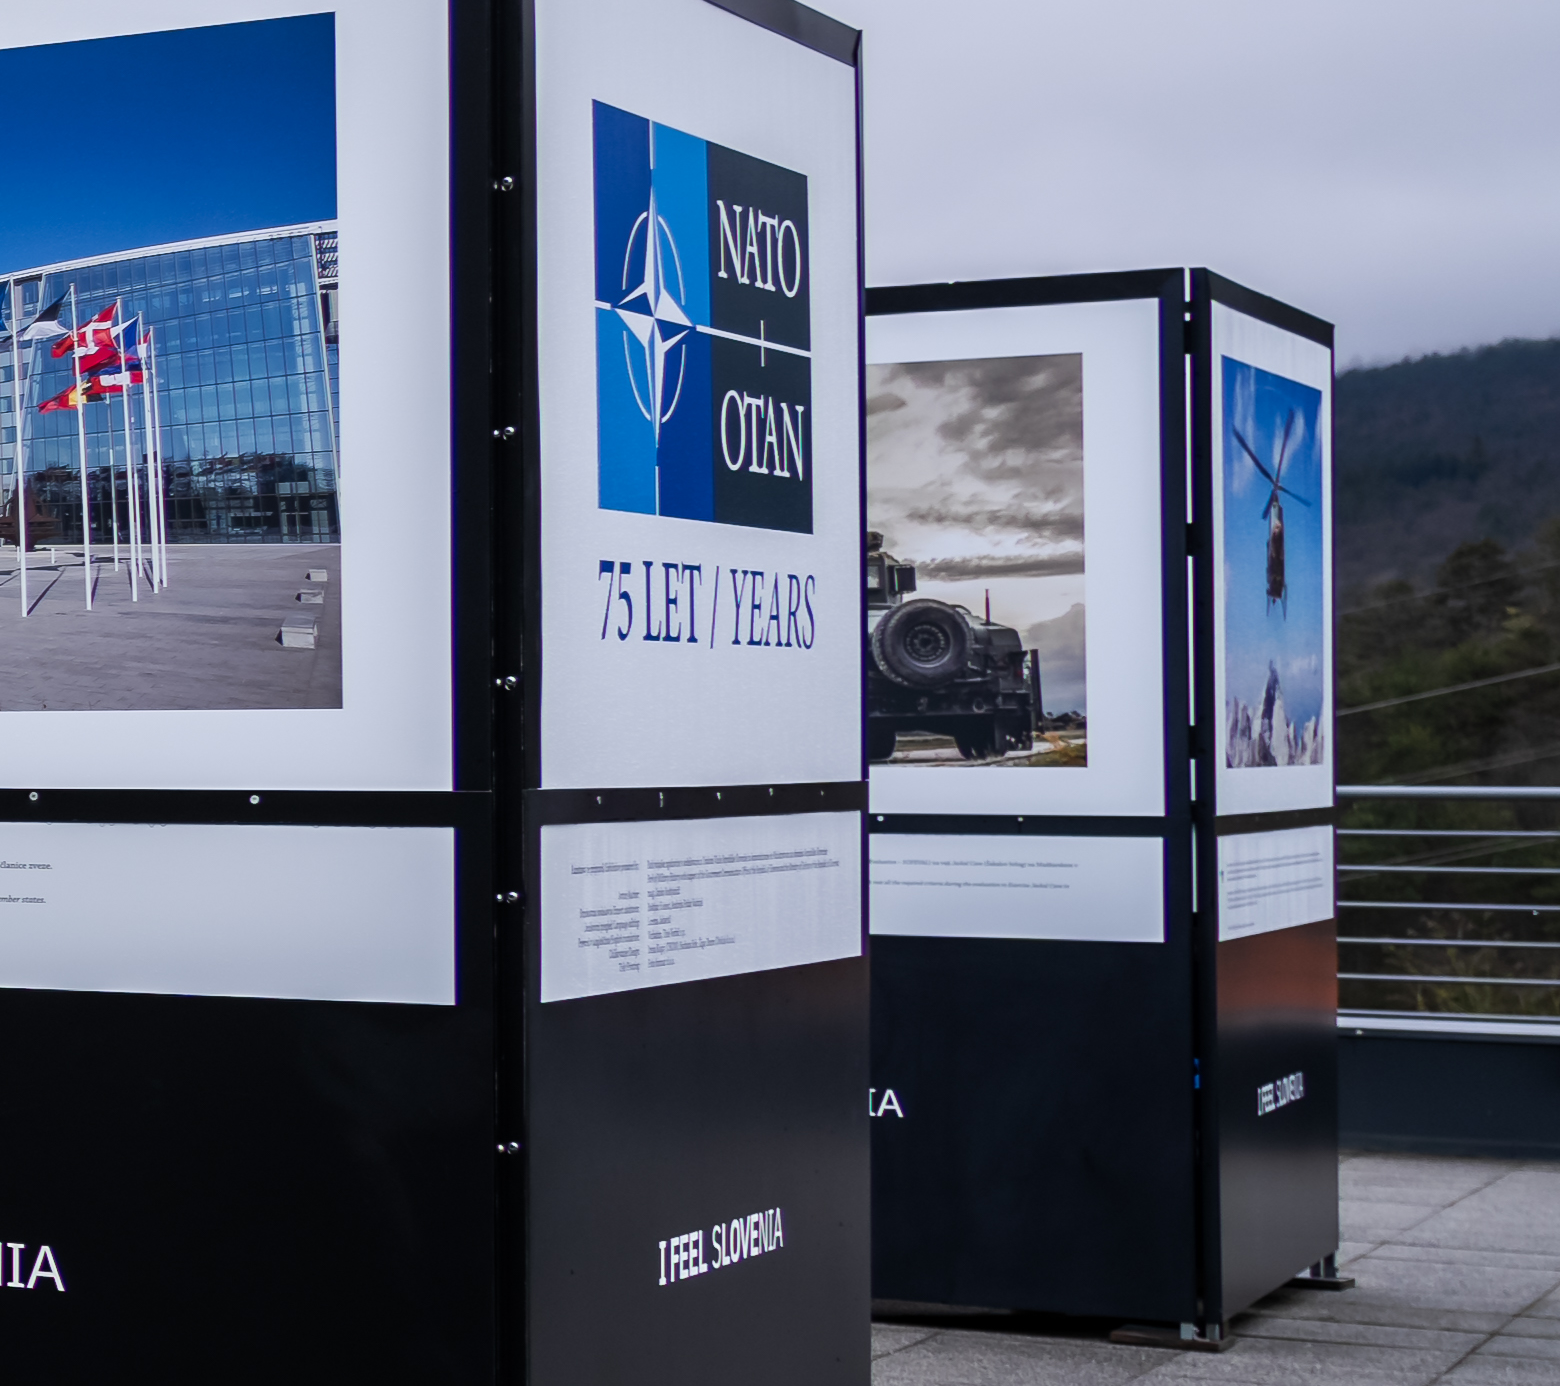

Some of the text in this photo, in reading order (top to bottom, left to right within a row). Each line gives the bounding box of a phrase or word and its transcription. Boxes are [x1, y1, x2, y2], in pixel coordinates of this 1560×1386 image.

[716, 199, 801, 298] NATO
[720, 388, 804, 481] OTAN
[598, 560, 816, 650] 75 LET / YEARS
[658, 1206, 784, 1286] I FEEL SLOVENIA
